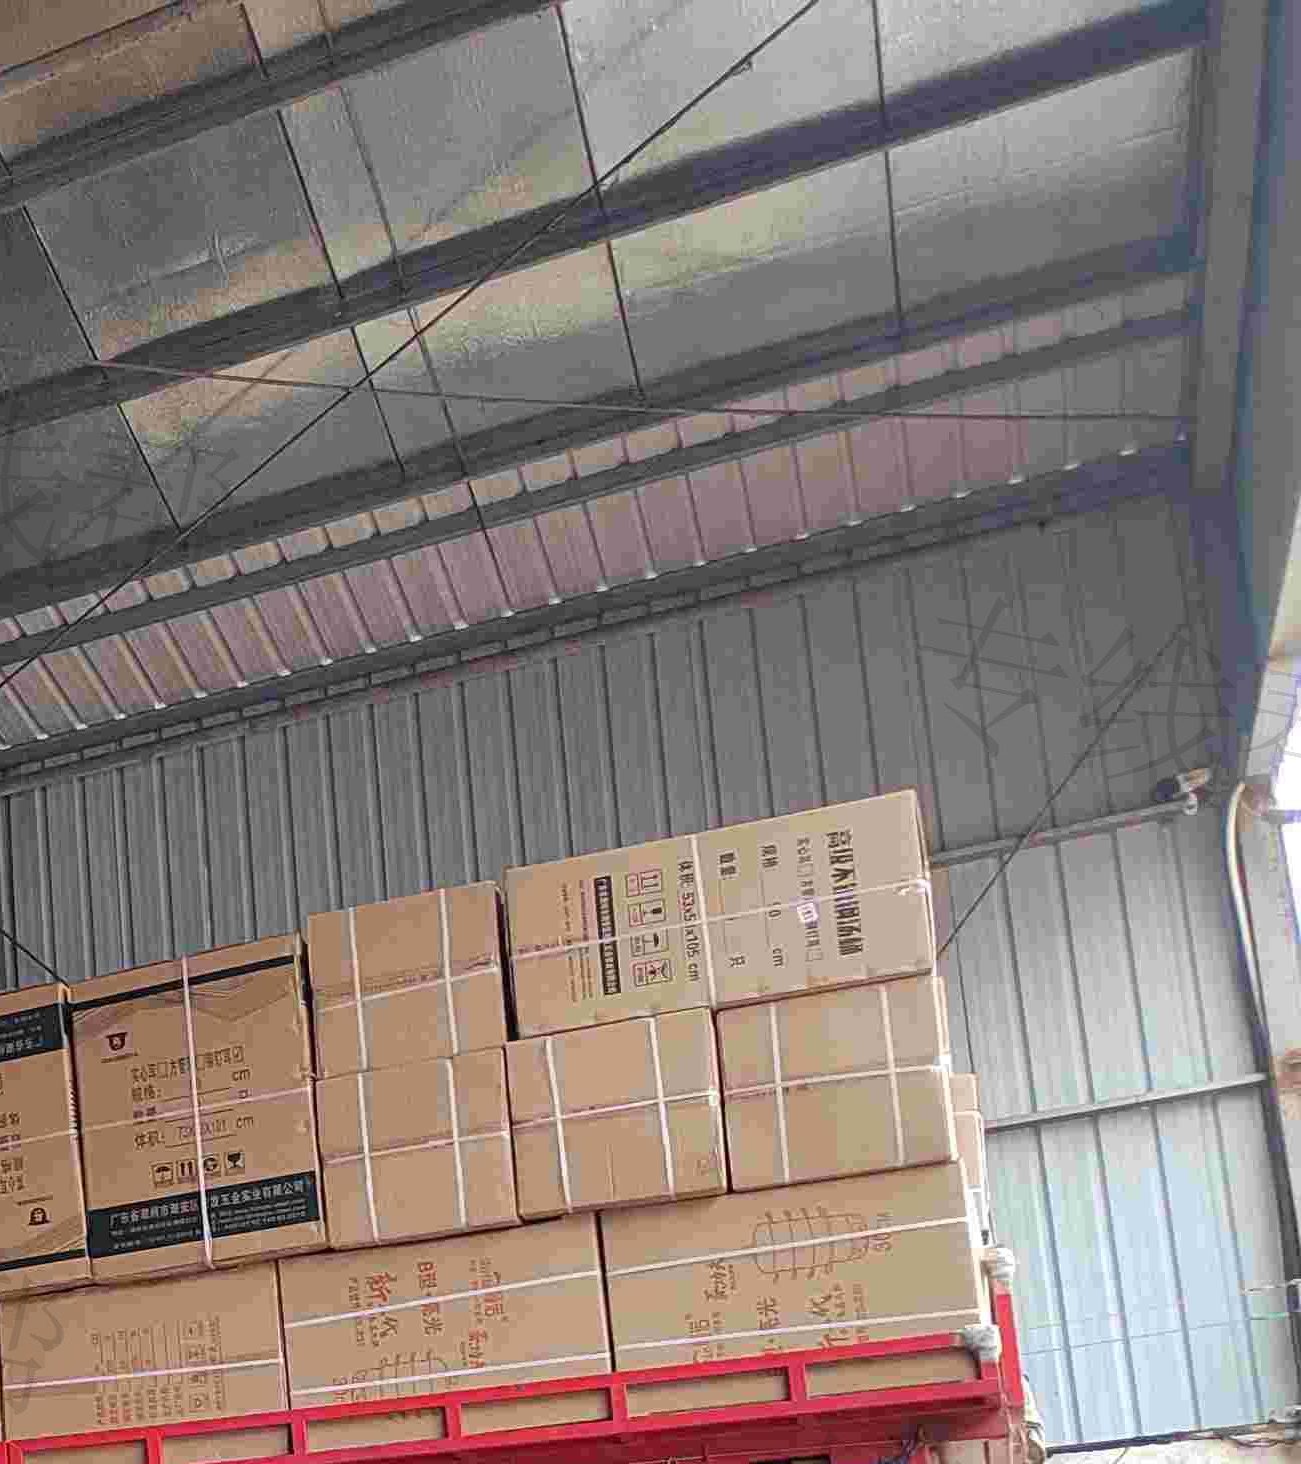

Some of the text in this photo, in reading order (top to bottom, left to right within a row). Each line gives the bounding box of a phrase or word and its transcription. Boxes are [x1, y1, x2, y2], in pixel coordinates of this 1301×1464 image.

[772, 948, 786, 967] cm
[231, 1067, 252, 1083] cm
[236, 1115, 255, 1130] cm
